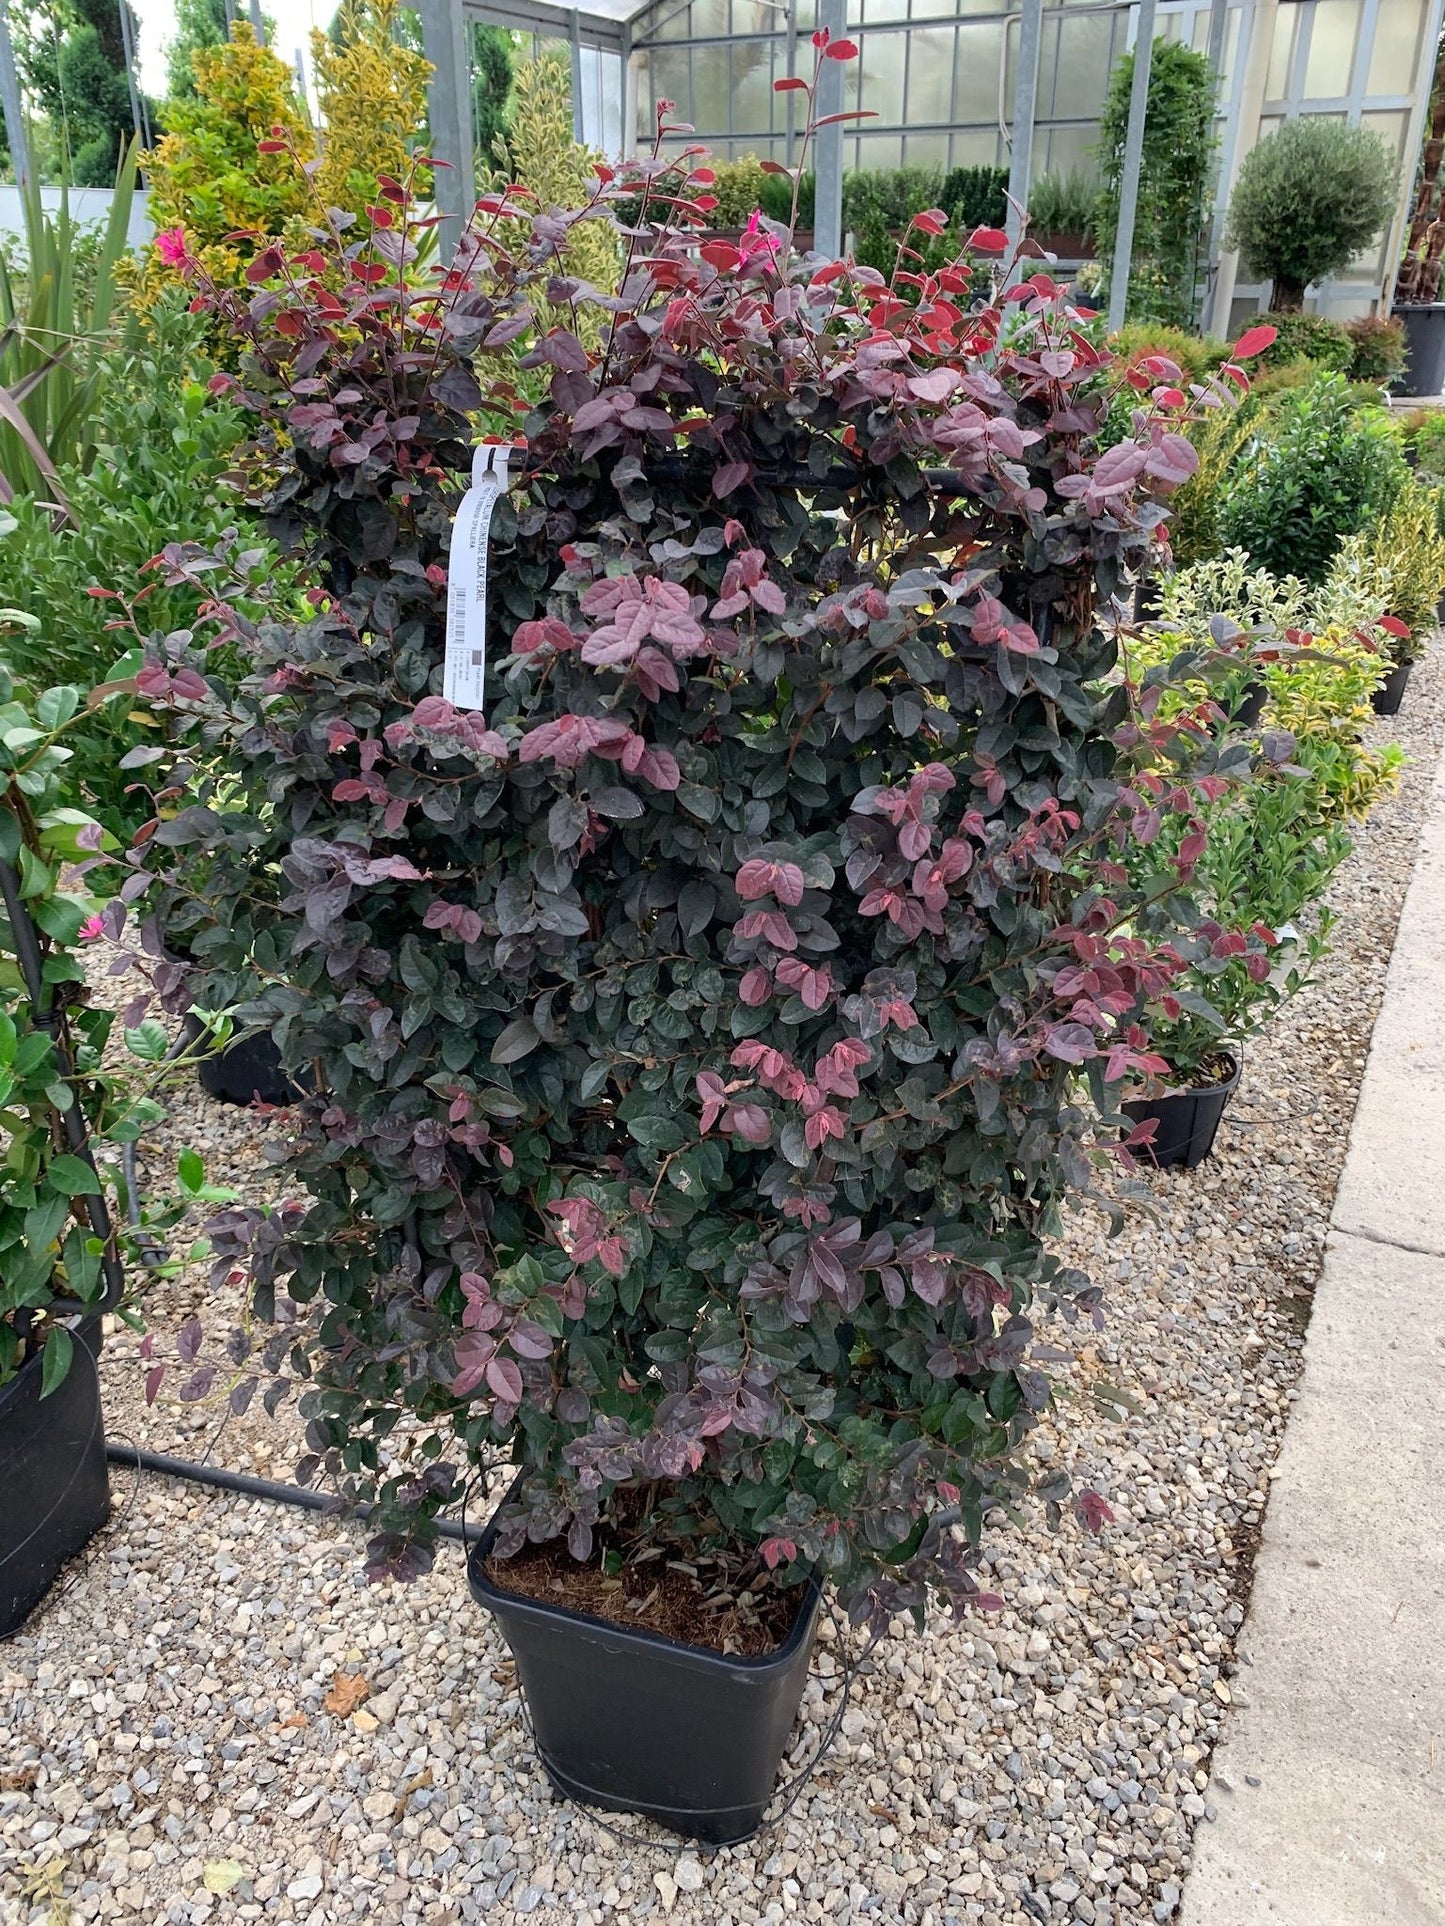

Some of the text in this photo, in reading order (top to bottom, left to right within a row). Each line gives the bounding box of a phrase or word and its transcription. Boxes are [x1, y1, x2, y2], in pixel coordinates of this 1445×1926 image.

[482, 486, 499, 521] PETALUM
[478, 521, 488, 554] CHINENSE
[476, 556, 486, 579] BLACK
[475, 580, 485, 604] PEARL
